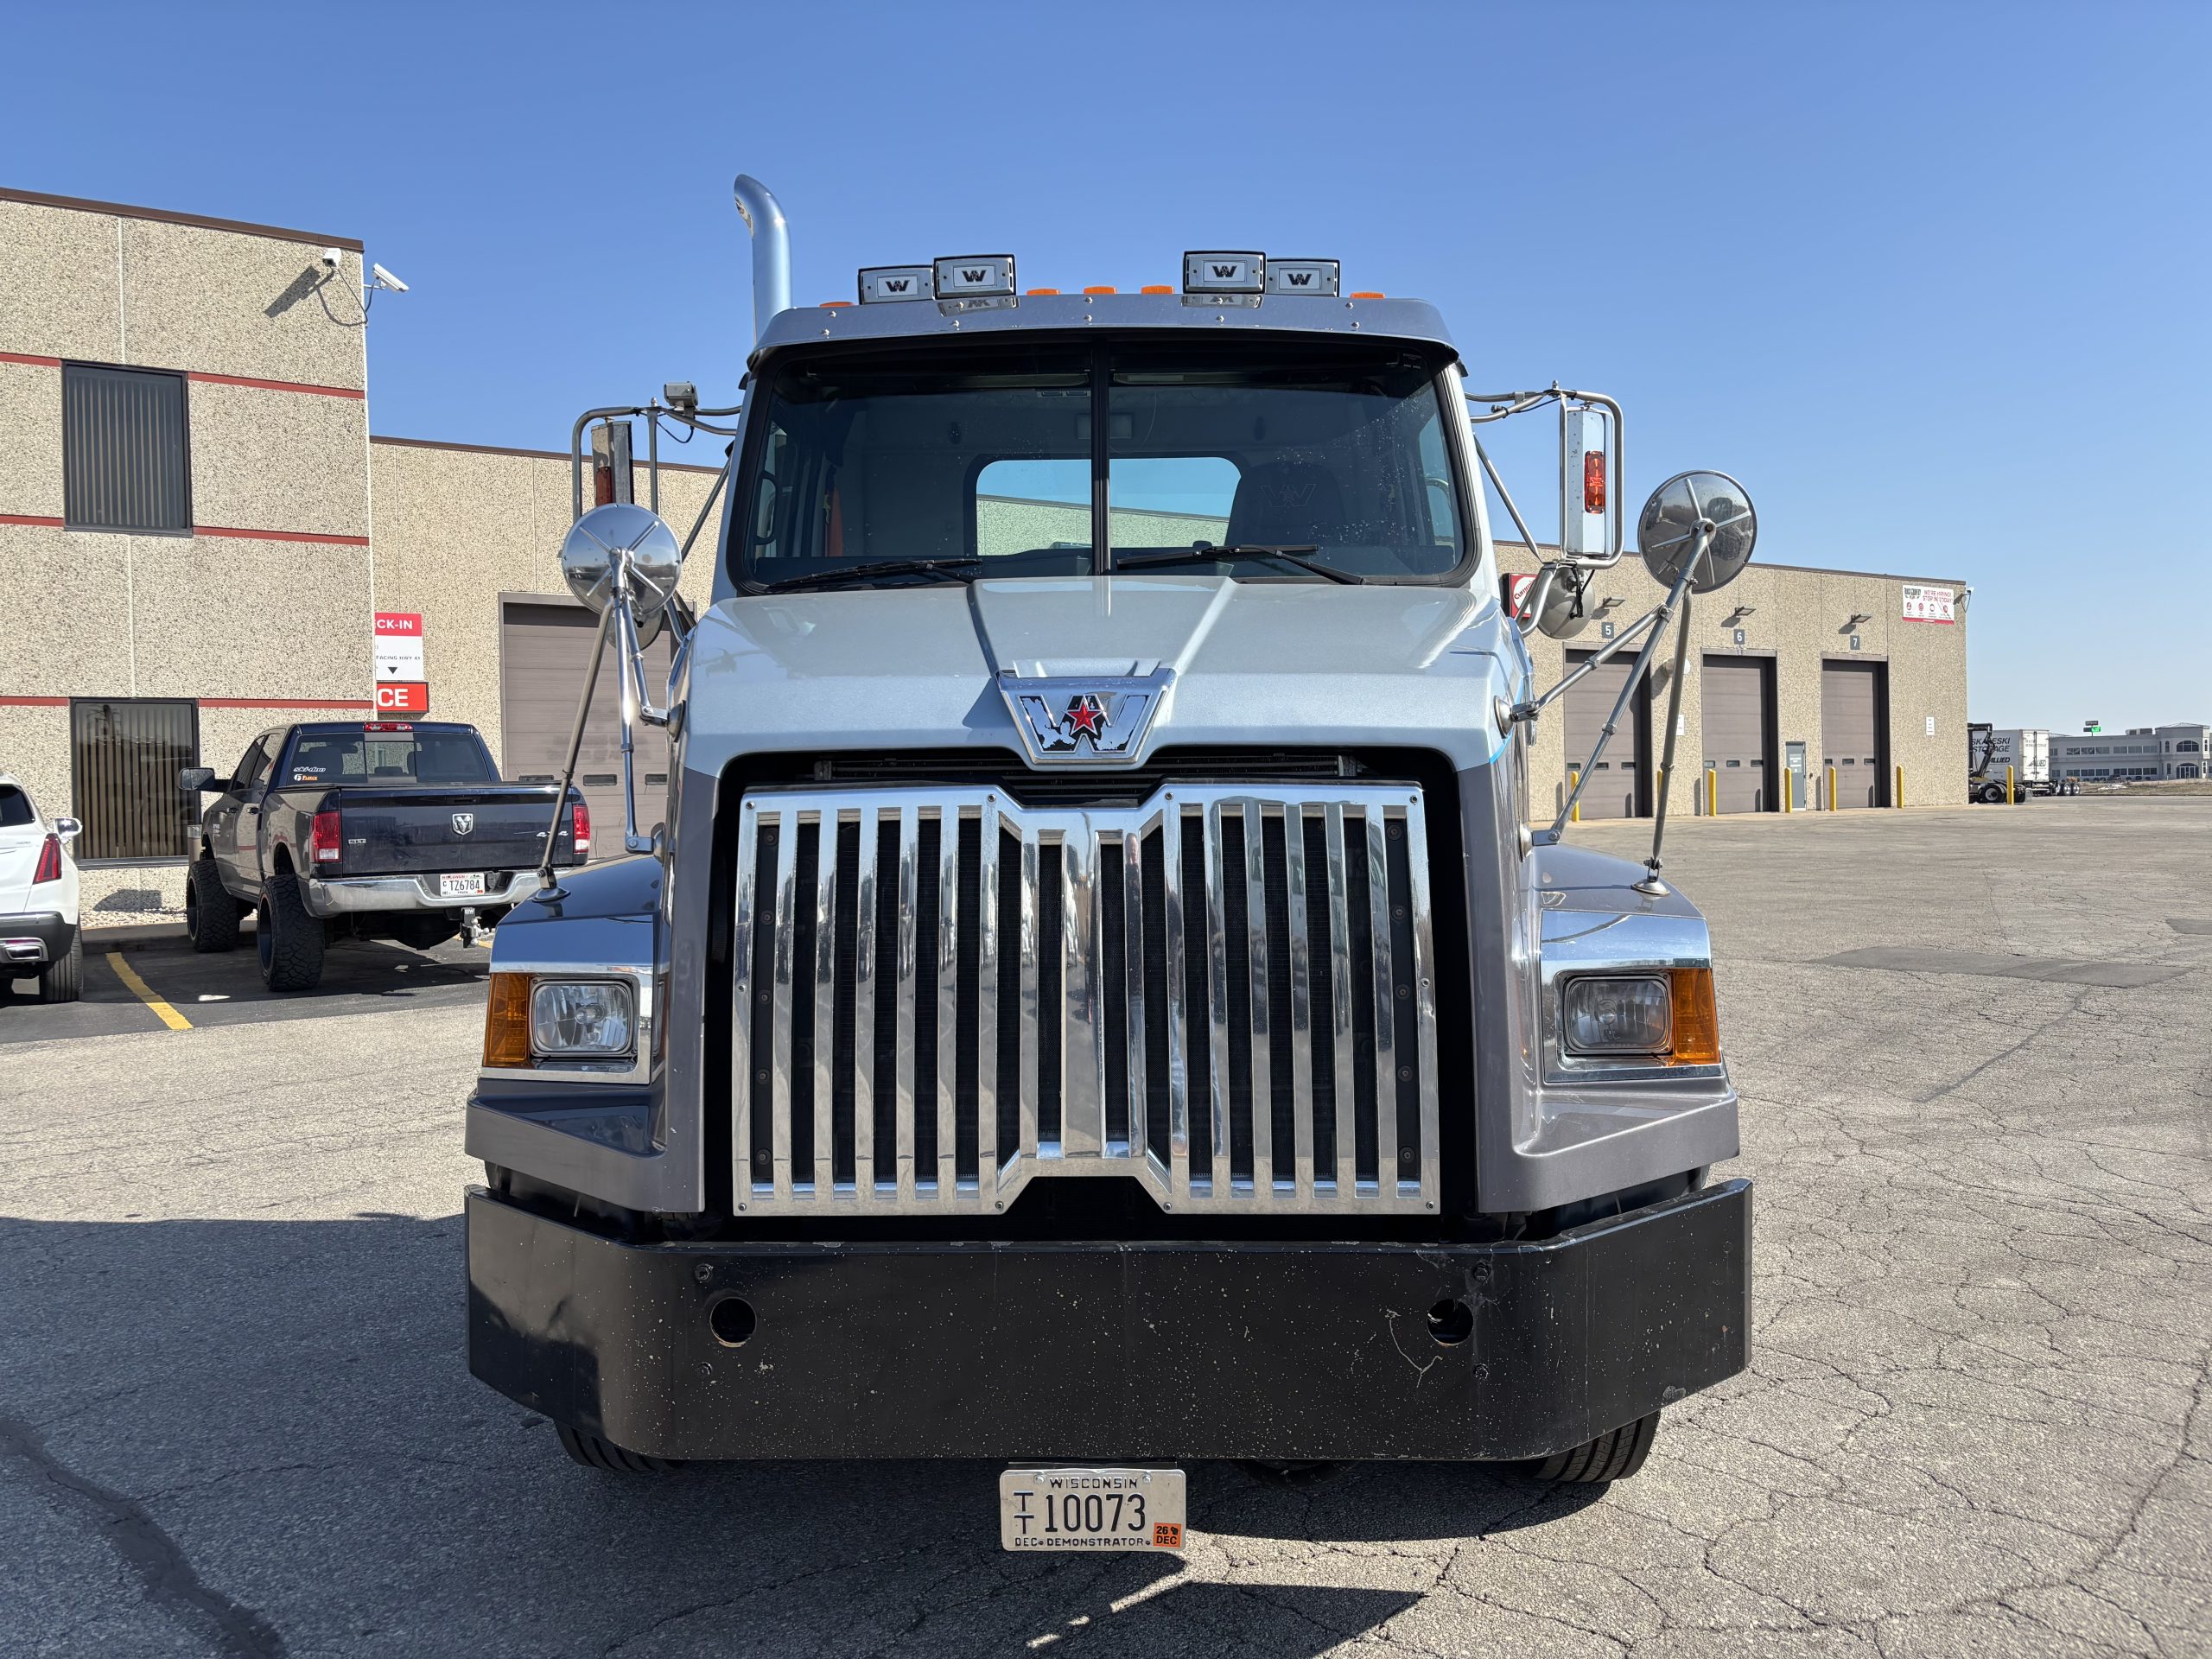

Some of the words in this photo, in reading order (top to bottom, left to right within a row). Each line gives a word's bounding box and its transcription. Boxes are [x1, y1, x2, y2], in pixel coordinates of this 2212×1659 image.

[375, 619, 413, 630] CK-IN
[1605, 625, 1611, 636] 5
[1737, 632, 1743, 642] 6
[1853, 637, 1858, 647] 7
[449, 880, 480, 891] TZ6784
[1049, 1478, 1137, 1489] WISCONSIN
[1045, 1493, 1146, 1533] 10073
[1014, 1537, 1037, 1547] DEC
[1046, 1537, 1144, 1547] DEMONSTRATOR
[1156, 1535, 1177, 1544] DEC
